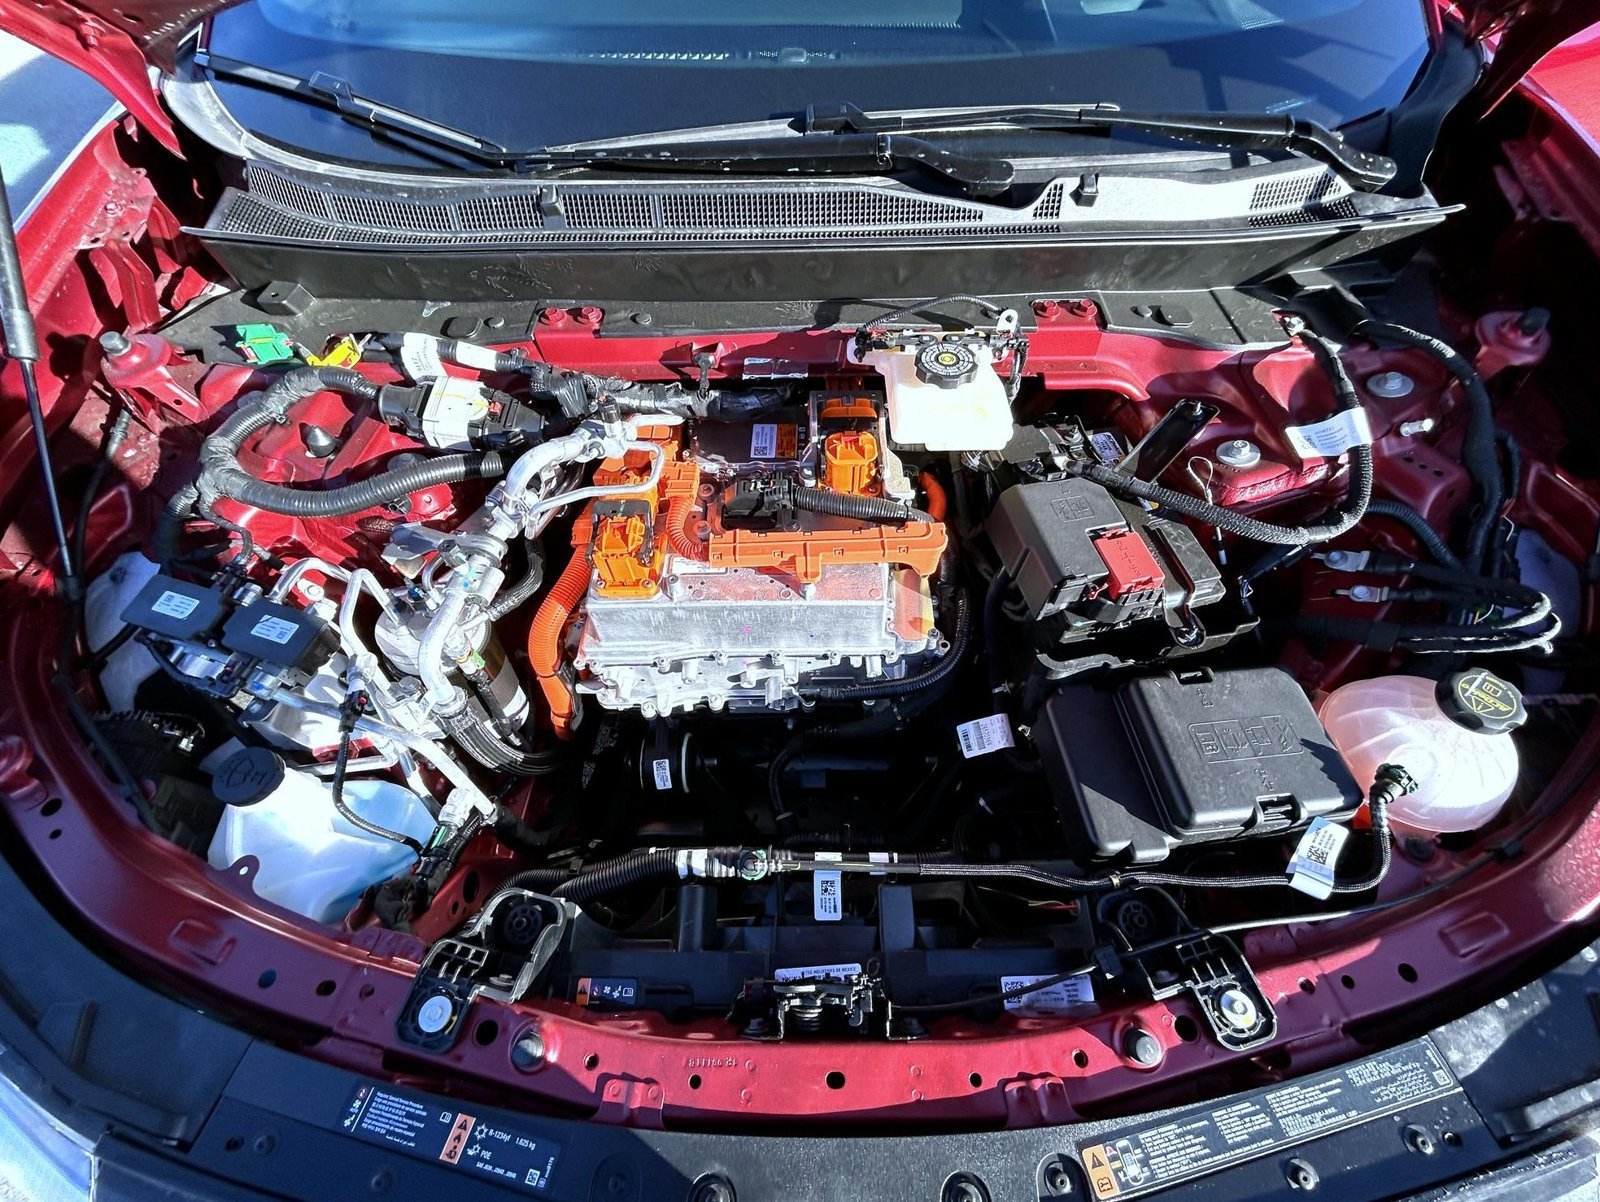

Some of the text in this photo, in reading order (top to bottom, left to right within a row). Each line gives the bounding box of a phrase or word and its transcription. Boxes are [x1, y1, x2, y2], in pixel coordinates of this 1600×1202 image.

[488, 1129, 511, 1142] R-1234yf
[529, 1141, 536, 1151] kg
[480, 1150, 492, 1160] POE
